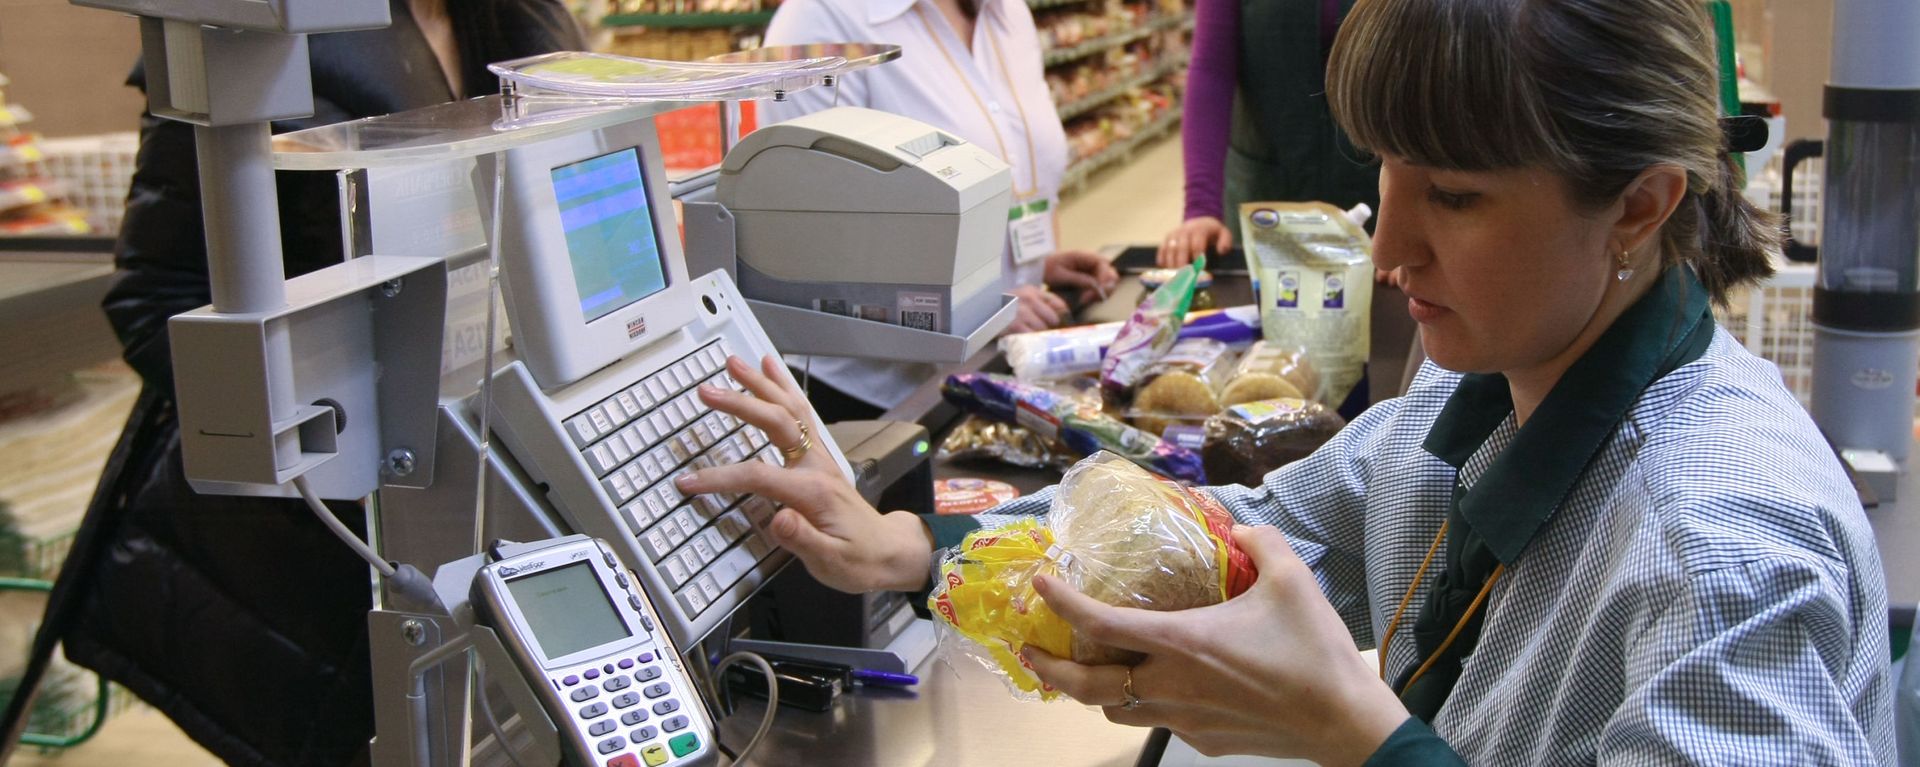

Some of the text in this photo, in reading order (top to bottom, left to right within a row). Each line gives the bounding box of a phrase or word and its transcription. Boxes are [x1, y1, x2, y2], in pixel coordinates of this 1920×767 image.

[580, 668, 653, 697] 1 2 3
[590, 684, 663, 714] 4 5 6
[598, 701, 672, 731] 7 8 9
[640, 728, 649, 739] 0
[671, 718, 680, 728] #
